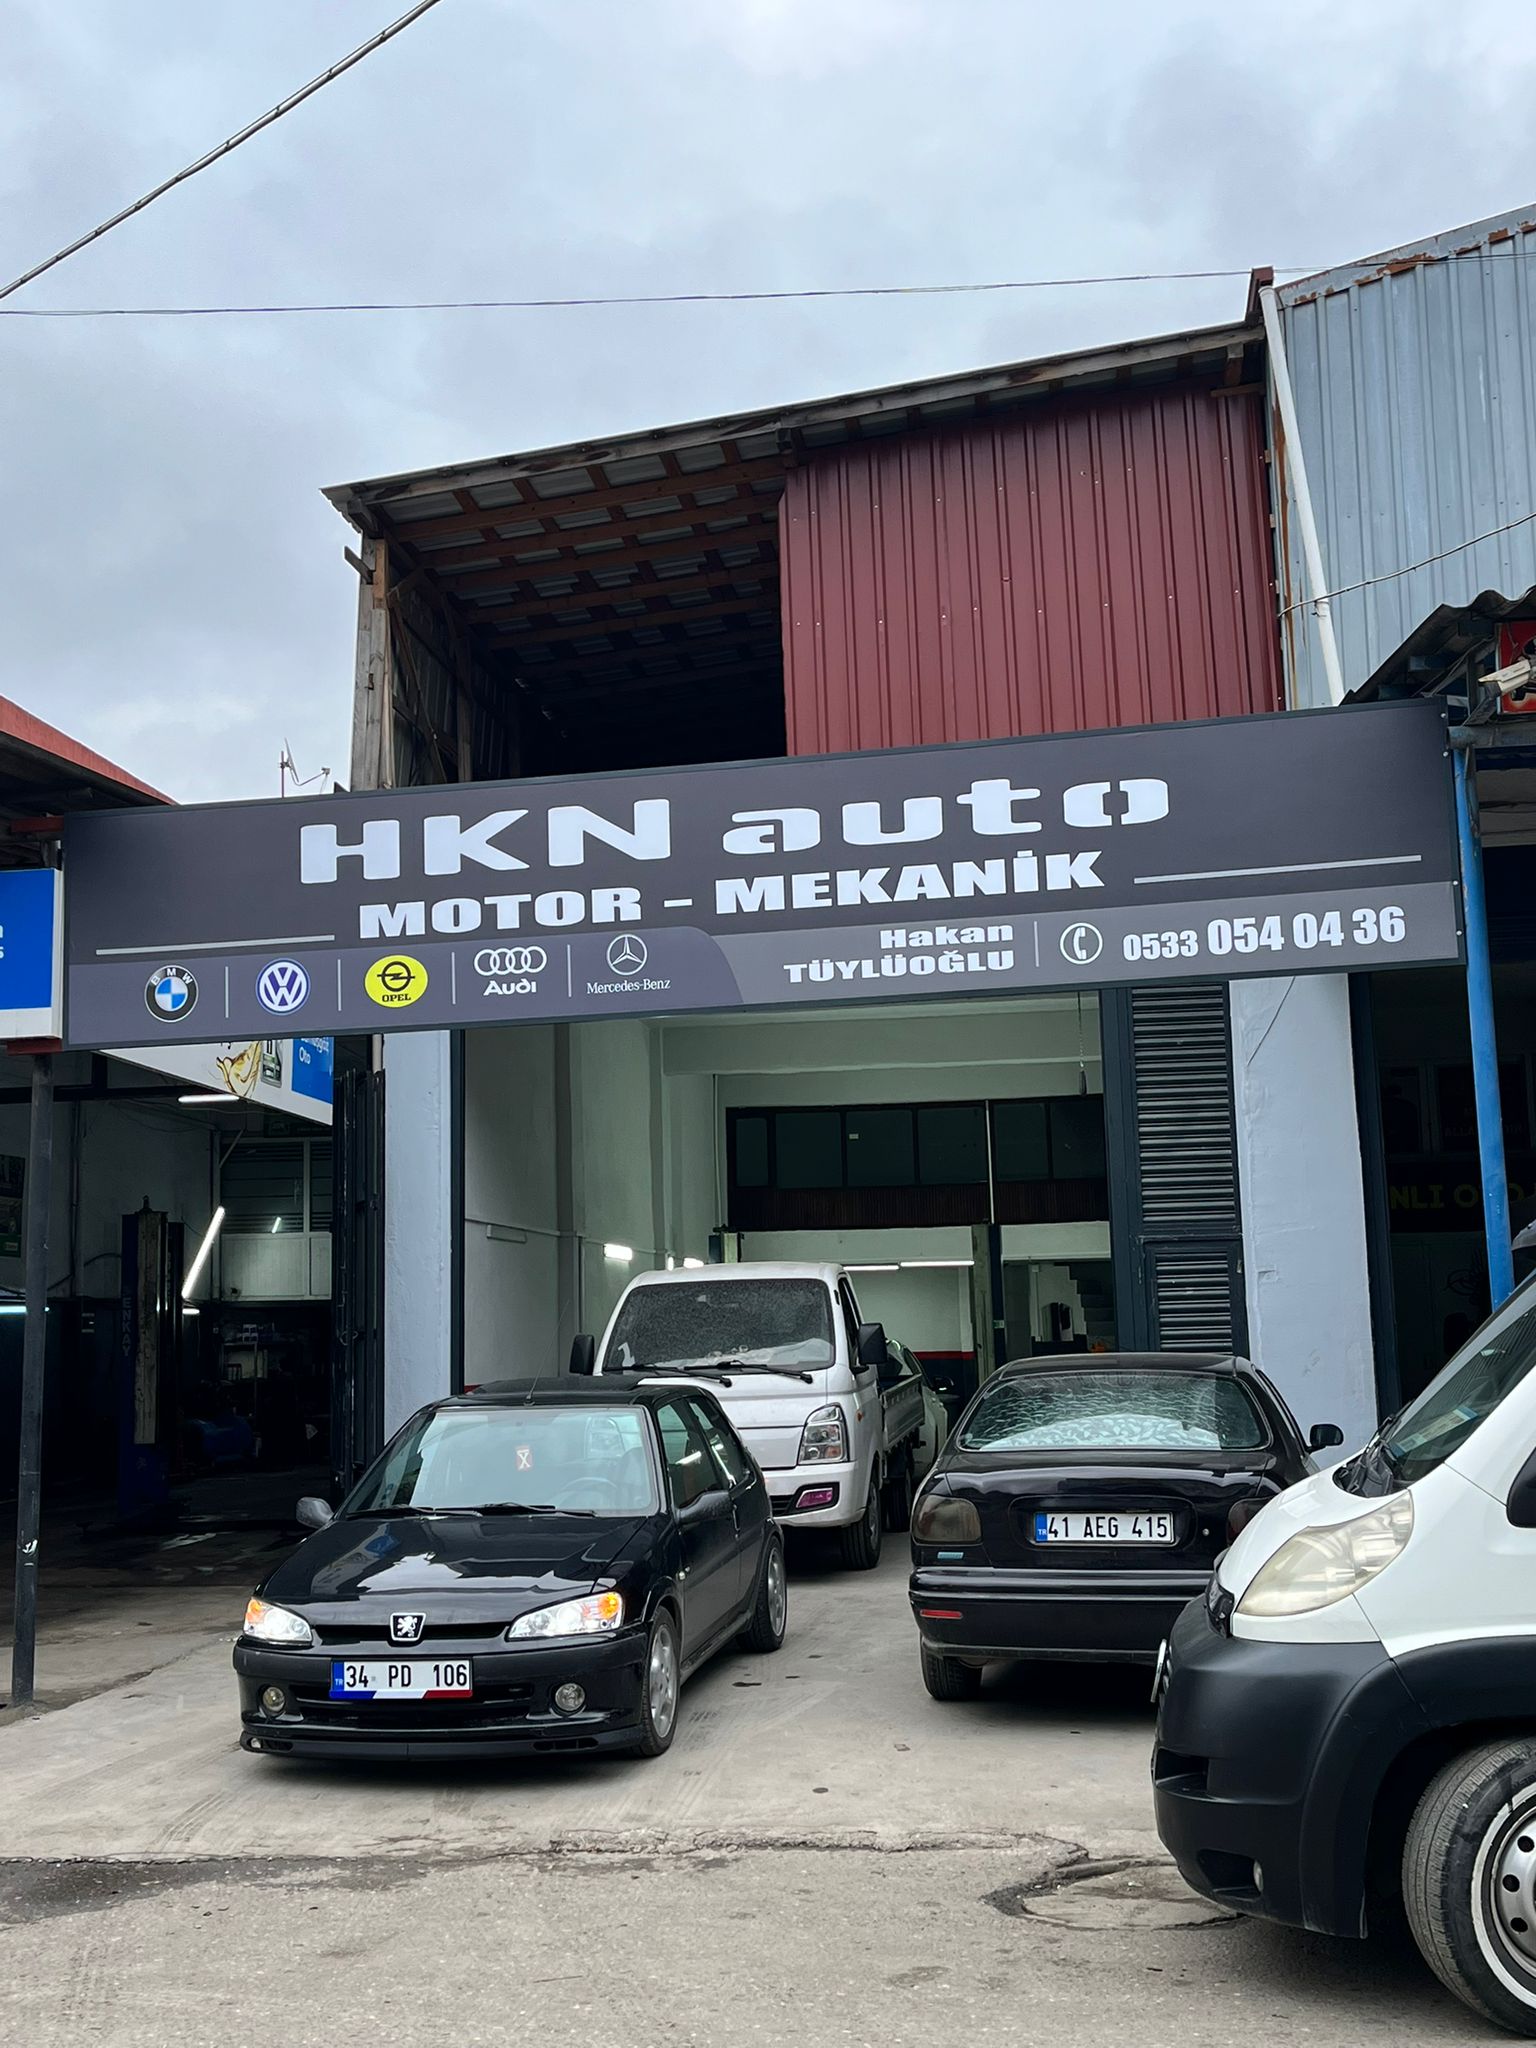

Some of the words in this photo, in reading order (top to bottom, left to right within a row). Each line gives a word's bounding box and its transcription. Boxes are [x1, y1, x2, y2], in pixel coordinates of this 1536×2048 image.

[300, 798, 671, 884] HKN
[722, 778, 1170, 855] auto
[359, 887, 642, 939] MOTOR
[715, 849, 1105, 915] MEKANİK
[880, 924, 1014, 949] Hakan
[1122, 930, 1199, 962] 0533
[1207, 915, 1285, 956] 054
[1292, 911, 1345, 950] 04
[1352, 906, 1407, 945] 36
[150, 967, 193, 986] BMW
[783, 950, 1015, 983] TÜYLÜOĞLU
[381, 993, 412, 1003] OPEL
[482, 978, 537, 997] Audi
[586, 978, 672, 994] Mercedes-Benz
[1048, 1516, 1070, 1538] 41
[1083, 1516, 1119, 1538] AEG
[1131, 1516, 1168, 1538] 415
[345, 1665, 369, 1688] 34
[388, 1665, 412, 1688] PD
[433, 1664, 468, 1687] 106
